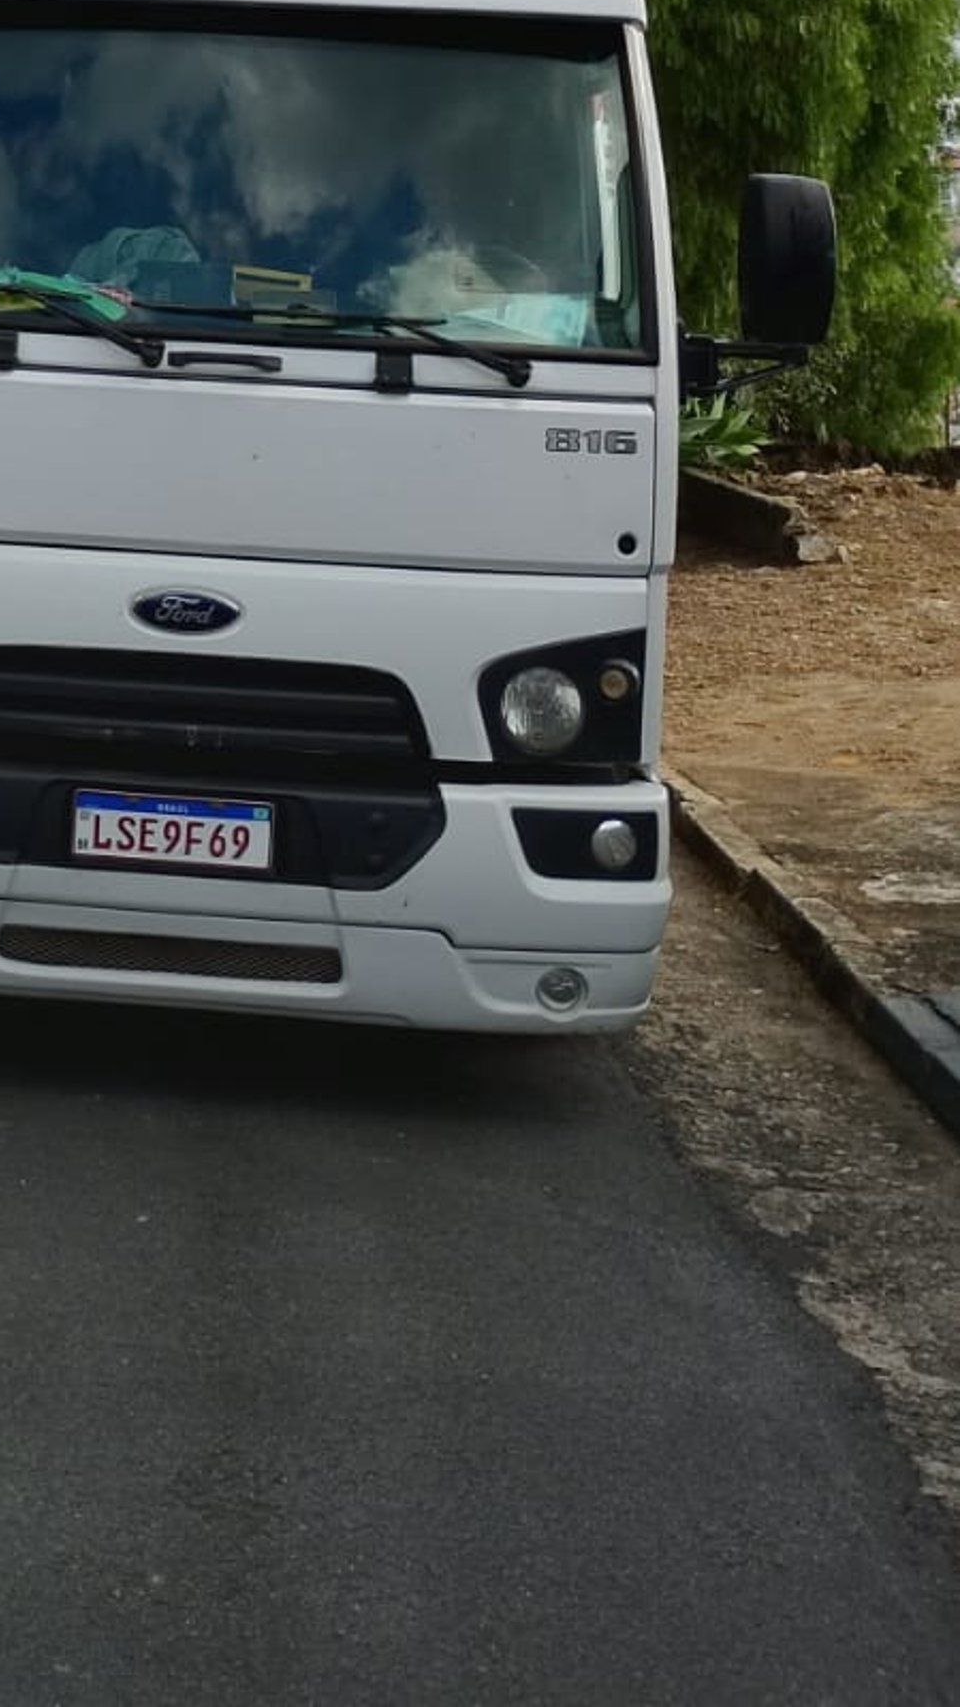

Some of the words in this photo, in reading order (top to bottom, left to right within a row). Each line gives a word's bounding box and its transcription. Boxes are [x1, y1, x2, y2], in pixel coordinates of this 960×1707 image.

[545, 427, 638, 454] 816
[155, 596, 216, 623] Ford
[93, 814, 251, 859] LSE9F69
